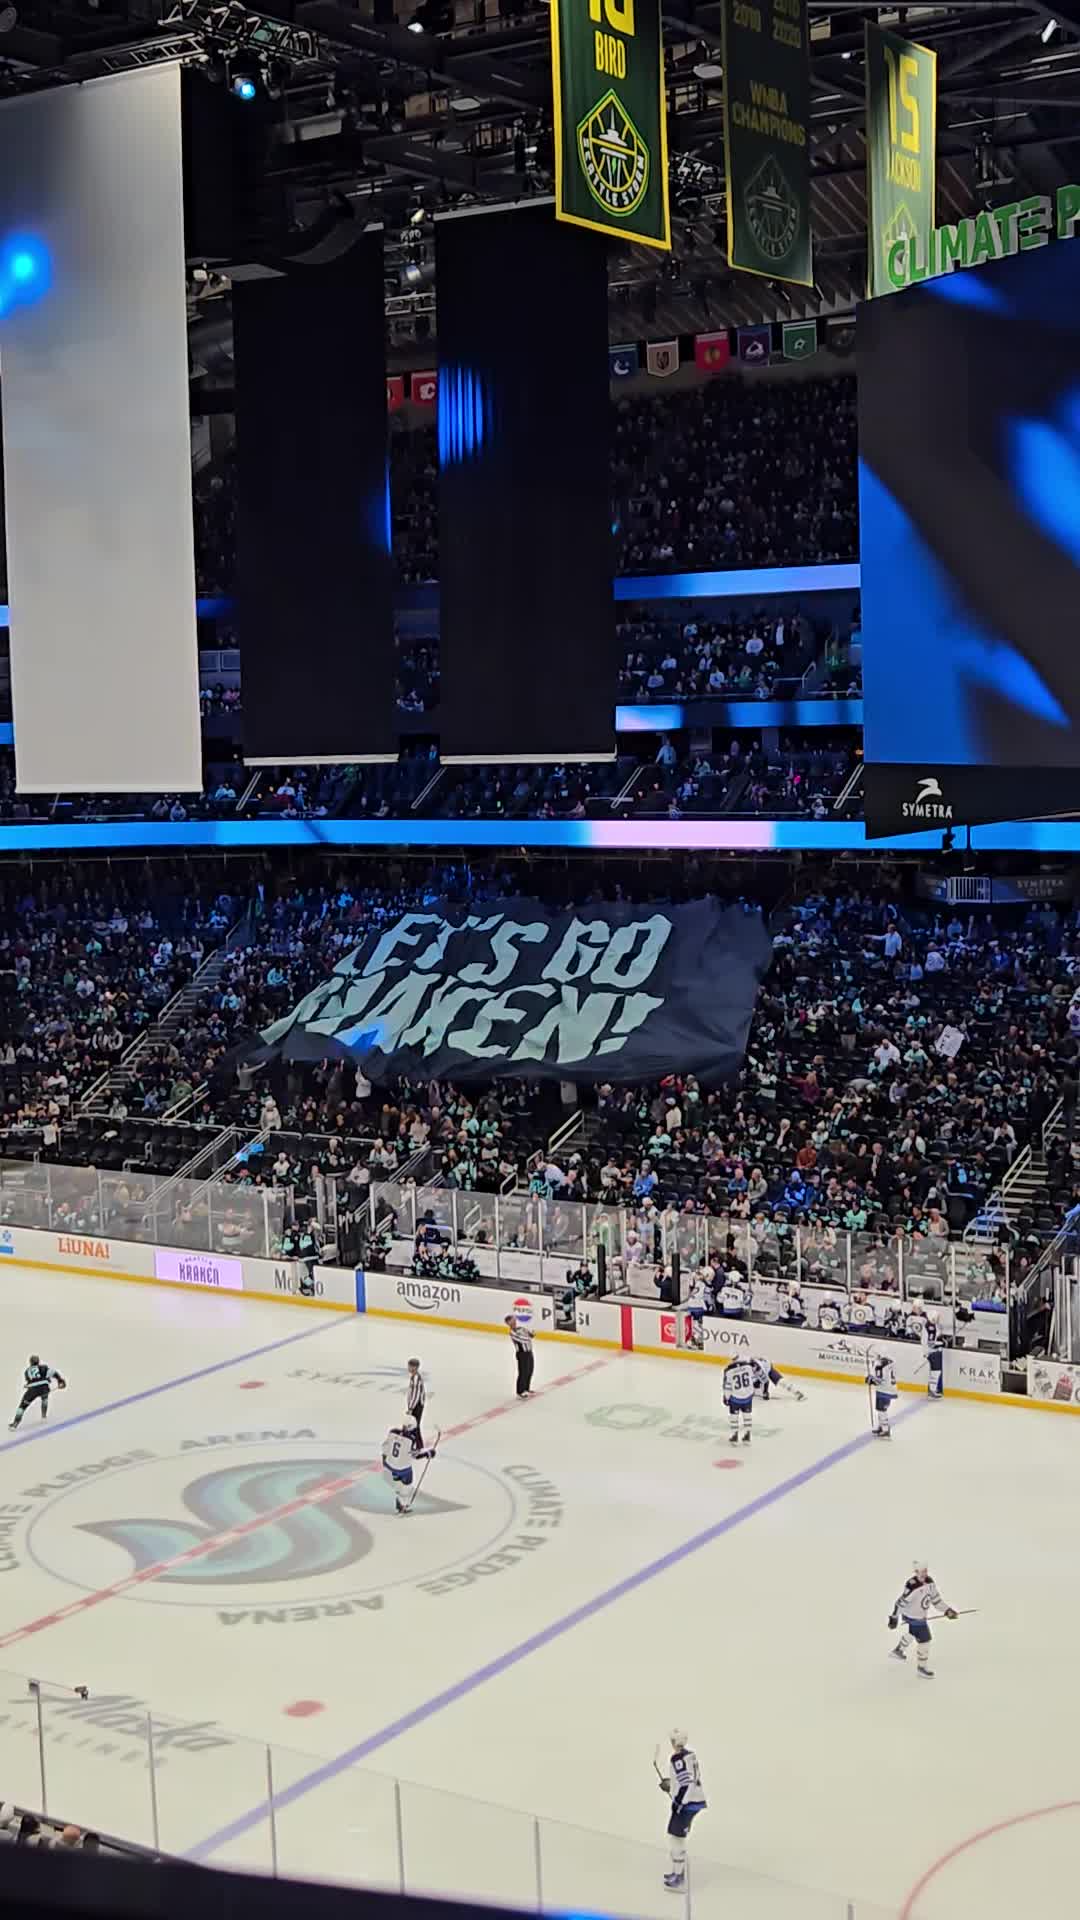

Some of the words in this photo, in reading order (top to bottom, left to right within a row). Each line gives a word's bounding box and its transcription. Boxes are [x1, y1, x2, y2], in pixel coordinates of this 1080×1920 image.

[595, 30, 626, 79] BIRD
[750, 80, 787, 114] WNBA
[884, 46, 920, 153] 15
[732, 101, 806, 146] CHAMPIONS
[887, 195, 1053, 288] CLIMATE
[902, 802, 953, 818] SYMETRA
[1016, 879, 1065, 890] SYMETRA
[541, 913, 673, 989] GO
[179, 1261, 220, 1286] KRAKEN
[396, 1281, 461, 1303] amazon
[541, 1307, 590, 1326] PSI
[702, 1328, 750, 1346] OYOTA
[732, 1371, 750, 1390] 36
[959, 1366, 1001, 1381] KRAK
[17, 1448, 160, 1498] PLEDGE
[180, 1427, 317, 1450] ARENA
[391, 1441, 401, 1458] 6
[502, 1464, 566, 1529] CLIMATE
[415, 1534, 549, 1597] PLEDGE
[215, 1594, 384, 1626] ARENA
